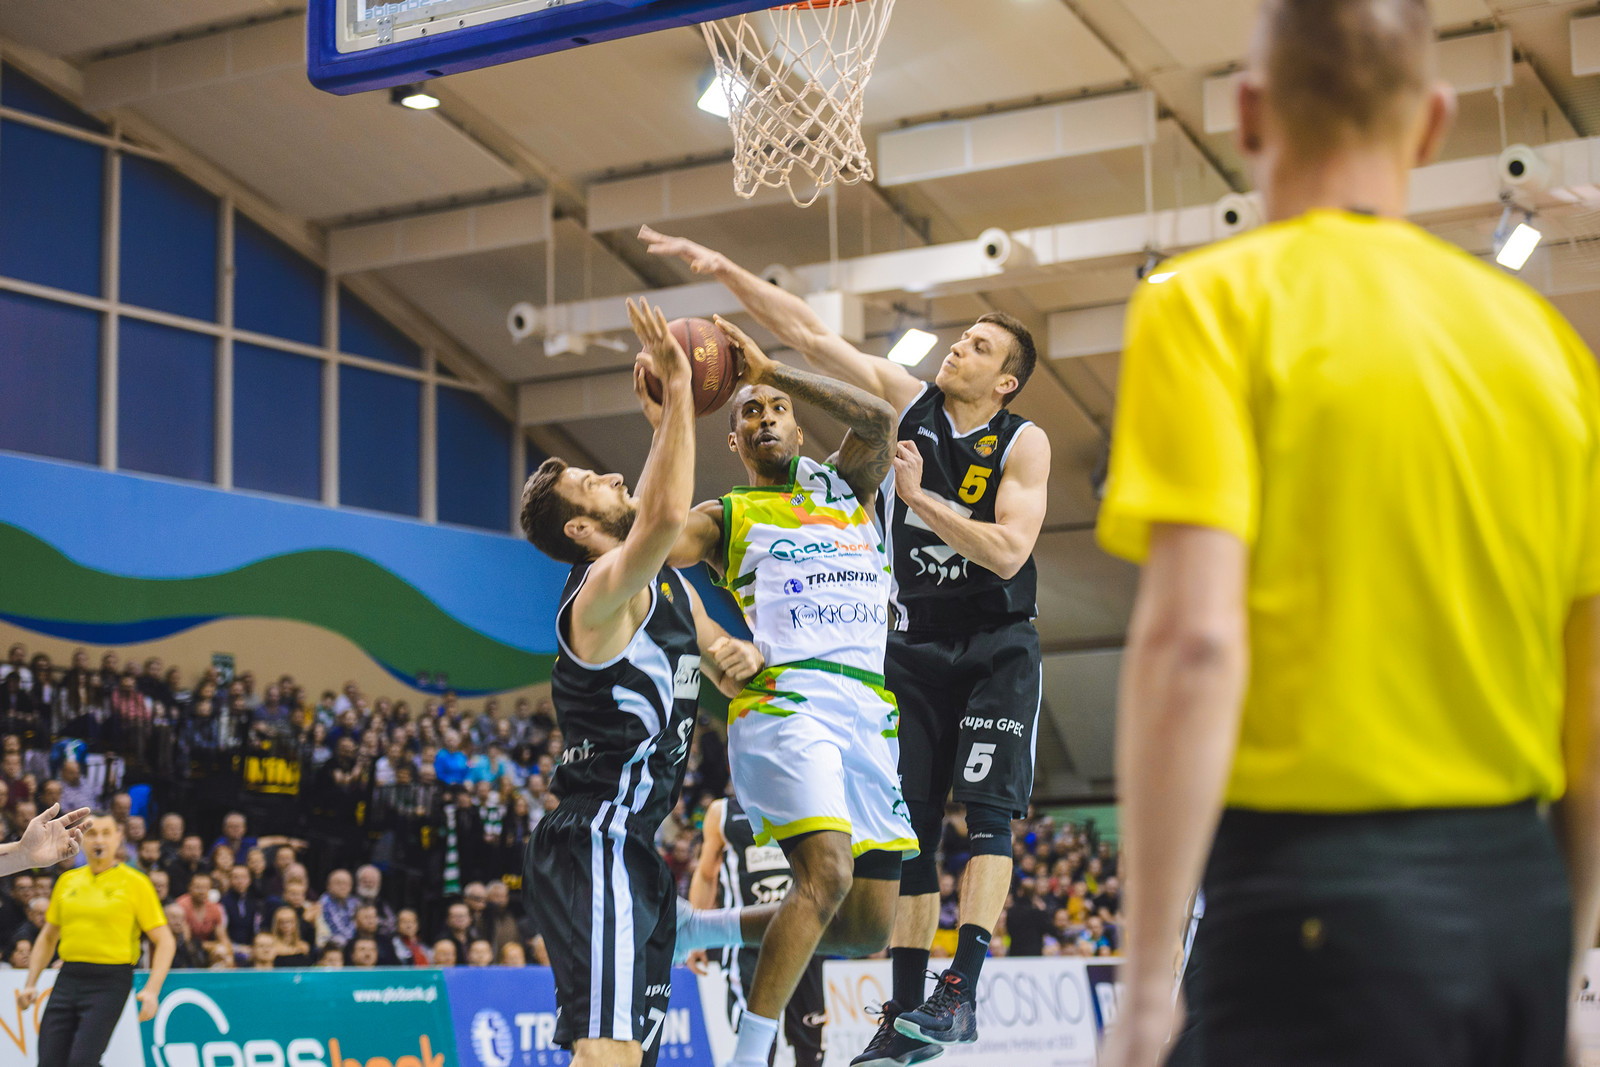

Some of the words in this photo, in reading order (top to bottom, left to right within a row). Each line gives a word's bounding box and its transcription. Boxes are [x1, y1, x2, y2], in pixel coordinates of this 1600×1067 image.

[809, 472, 855, 504] 2
[958, 464, 993, 504] 5
[818, 602, 887, 625] KROSNO
[963, 742, 997, 783] 5
[642, 1007, 666, 1052] 7
